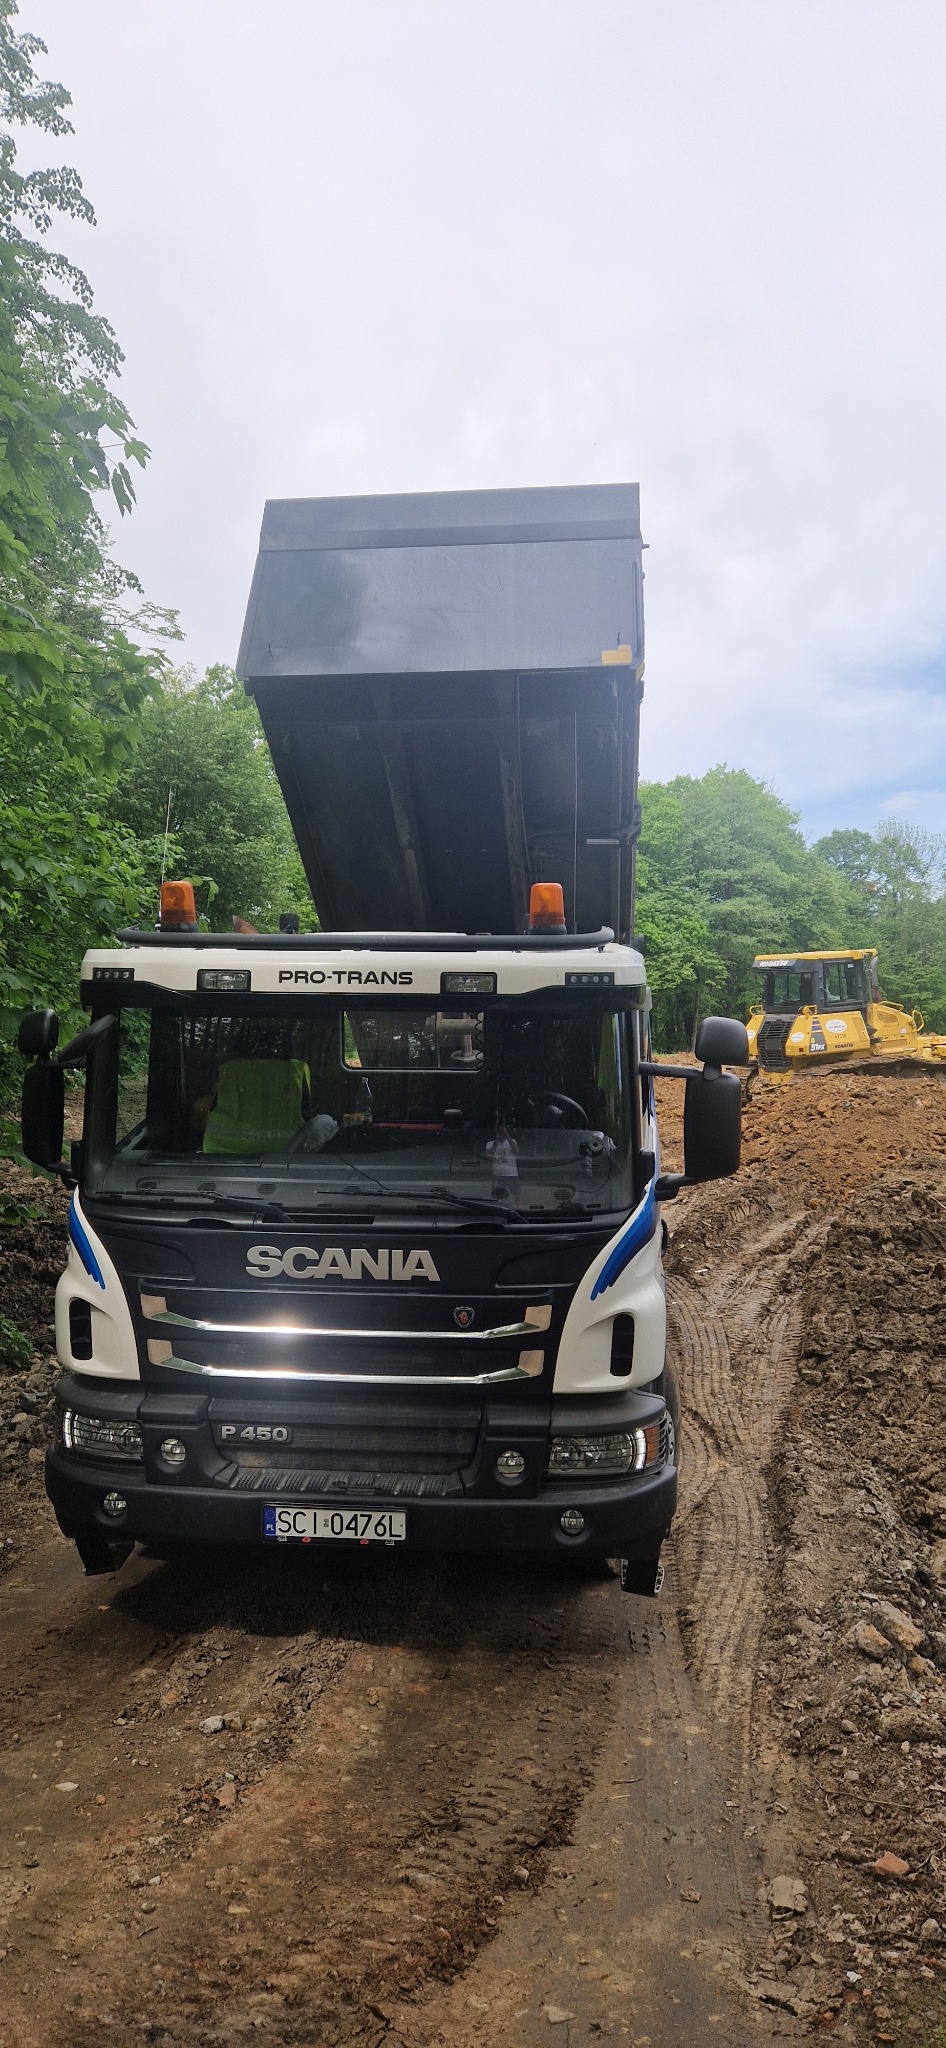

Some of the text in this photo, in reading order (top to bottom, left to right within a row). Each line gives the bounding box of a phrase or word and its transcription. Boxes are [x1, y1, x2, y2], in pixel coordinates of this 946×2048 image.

[278, 970, 414, 985] PRO-TRANS
[245, 1245, 441, 1282] SCANIA
[221, 1425, 288, 1442] P 450
[266, 1523, 275, 1531] PL
